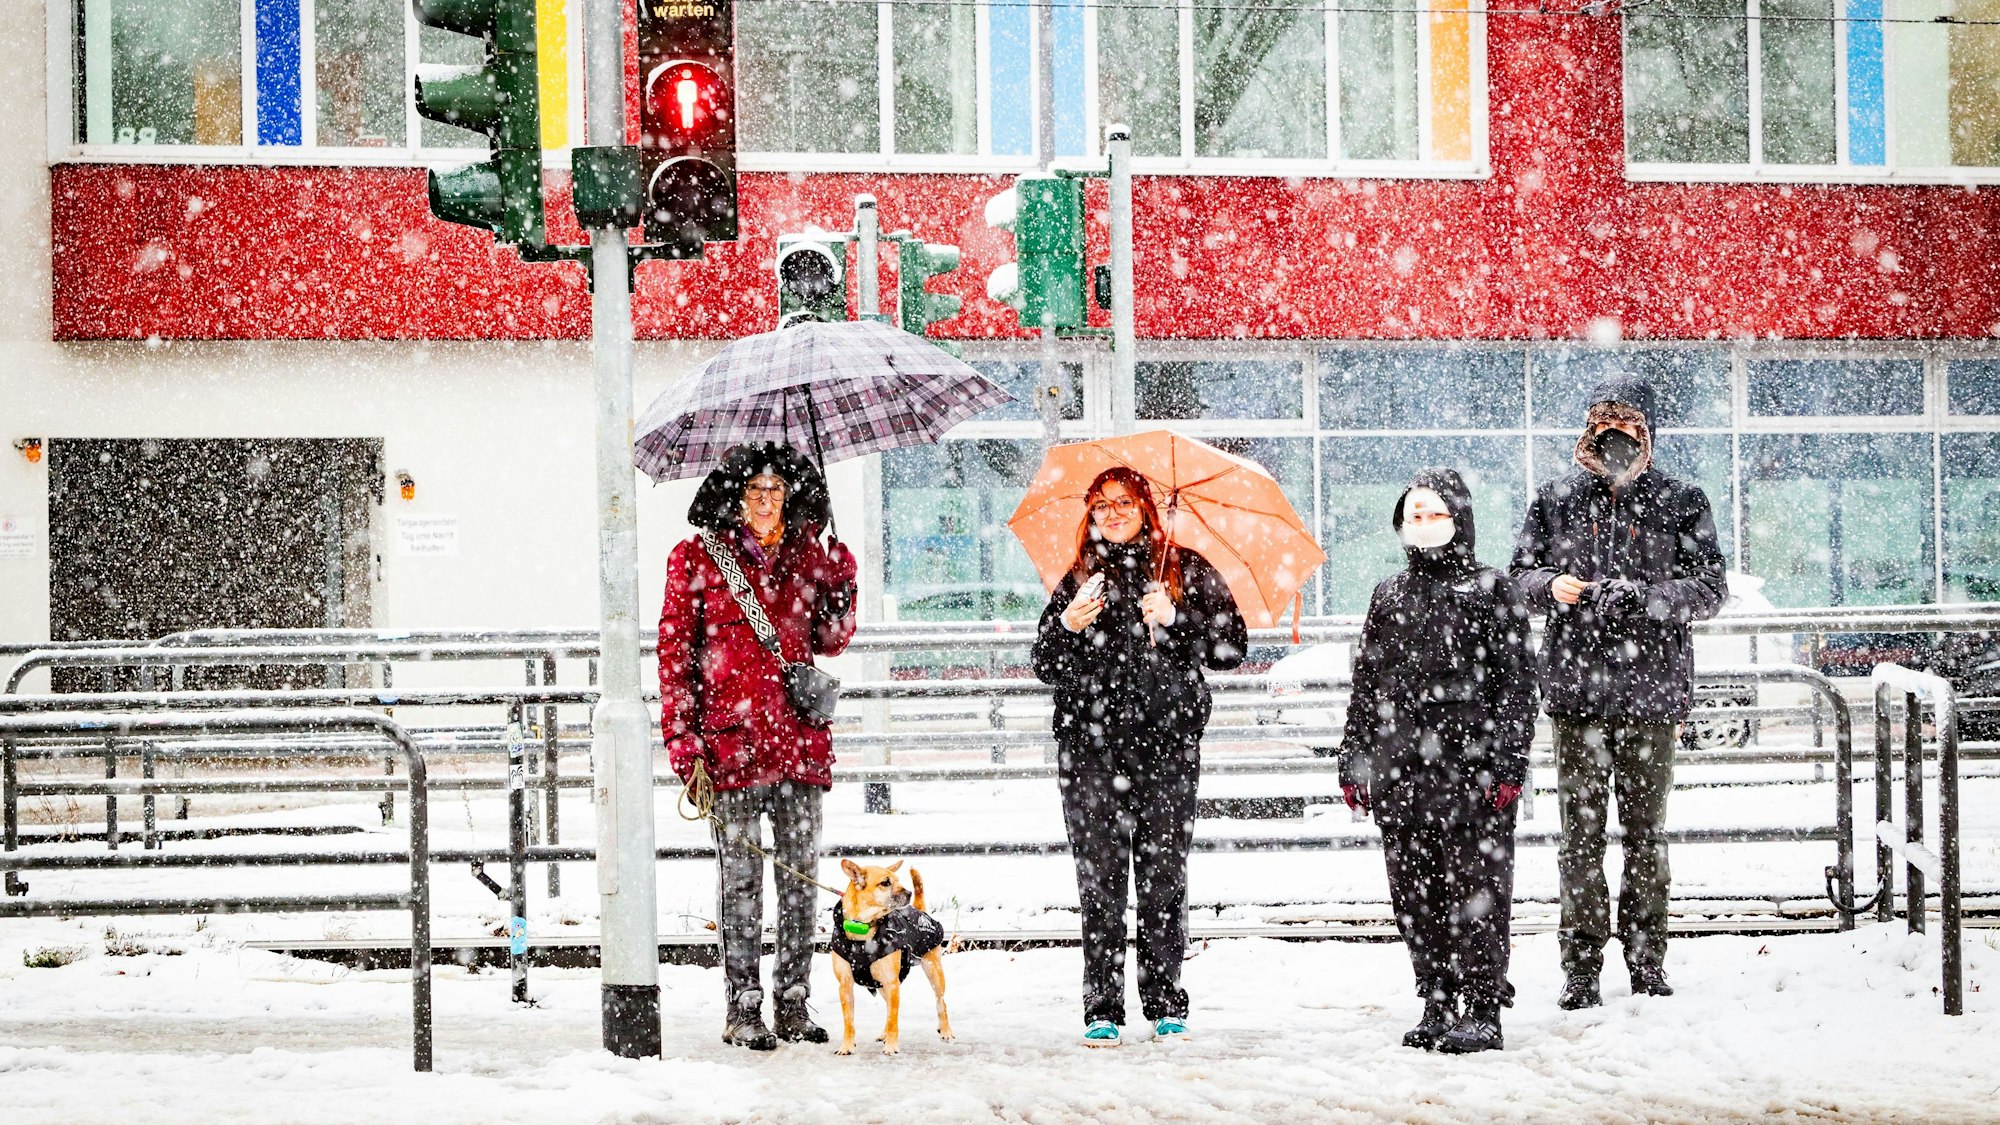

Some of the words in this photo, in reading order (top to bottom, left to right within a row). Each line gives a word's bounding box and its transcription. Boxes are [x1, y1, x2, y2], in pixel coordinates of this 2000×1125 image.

[653, 2, 714, 17] warten
[416, 531, 431, 540] und
[432, 531, 454, 539] Nacht
